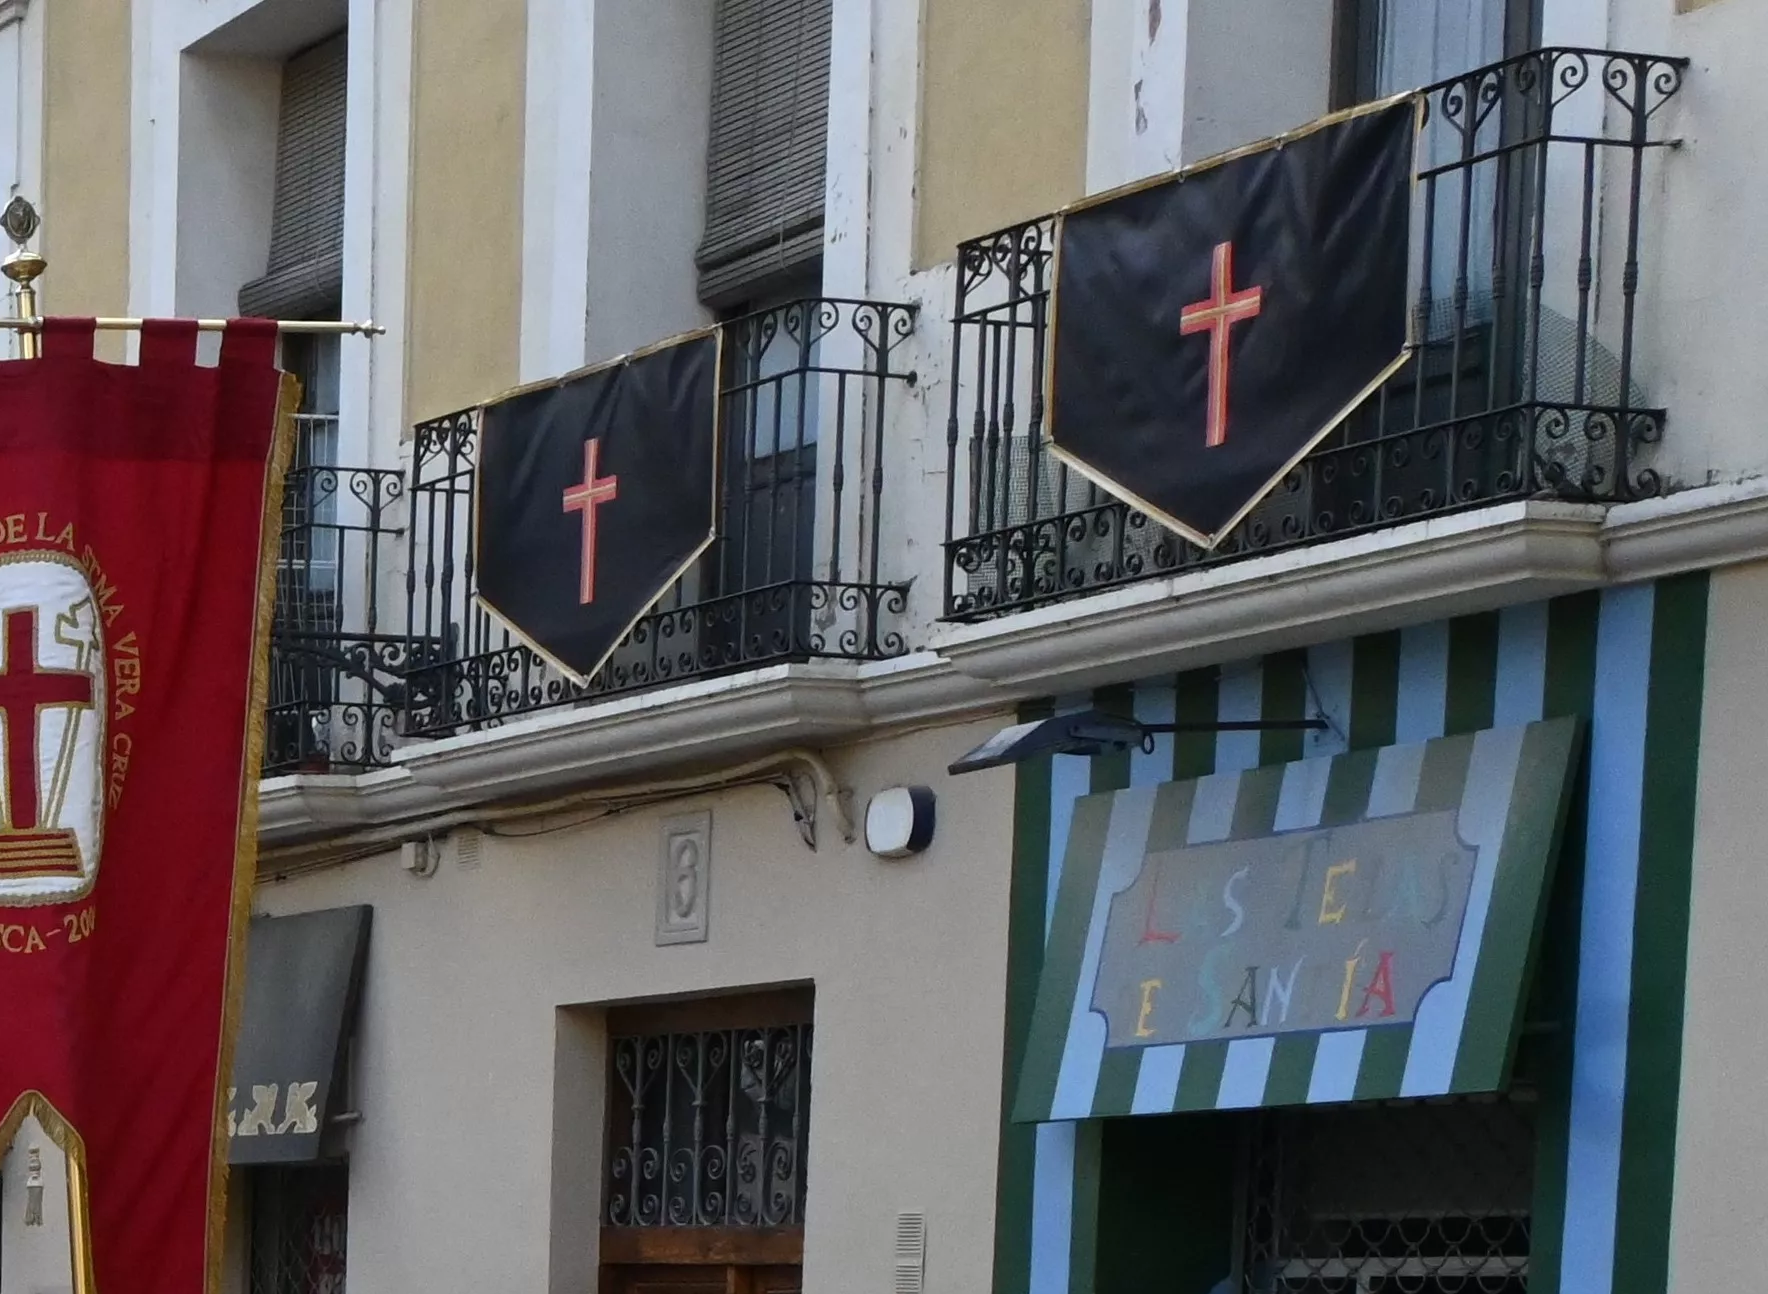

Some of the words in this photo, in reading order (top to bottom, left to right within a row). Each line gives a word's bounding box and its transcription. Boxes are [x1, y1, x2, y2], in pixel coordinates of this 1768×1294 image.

[35, 511, 76, 551] LA
[113, 630, 141, 721] VERA
[108, 732, 133, 810] CRUZ
[1187, 936, 1397, 1037] SANÍA
